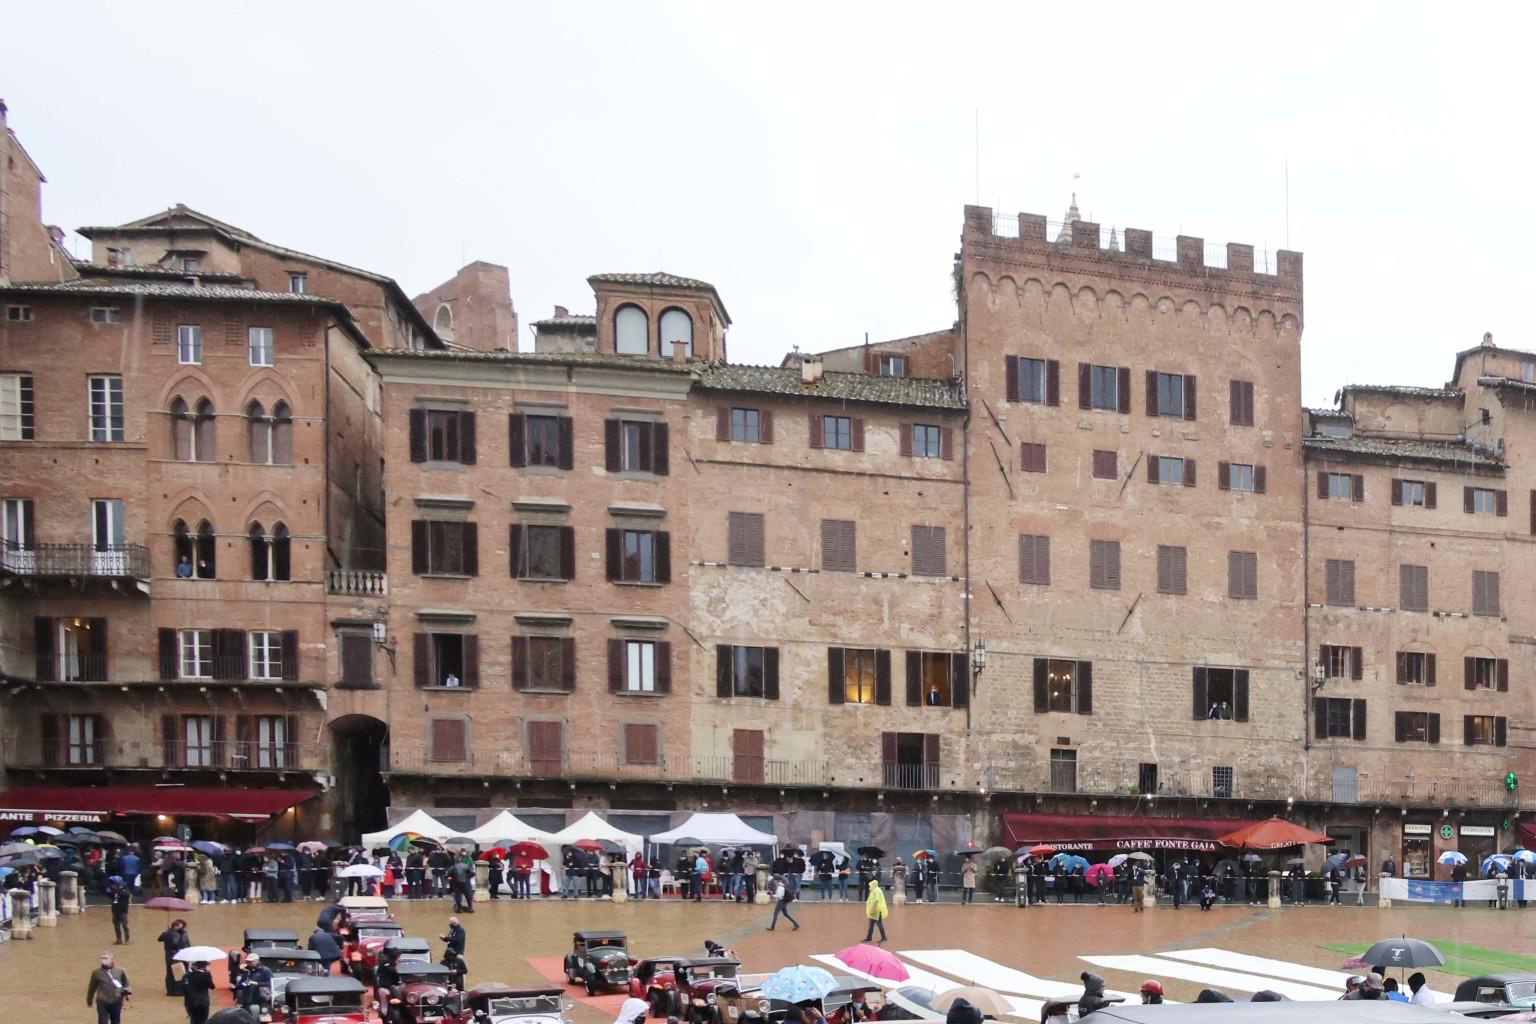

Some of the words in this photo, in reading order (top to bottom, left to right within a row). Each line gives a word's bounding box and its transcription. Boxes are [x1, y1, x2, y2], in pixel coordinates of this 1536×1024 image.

[44, 813, 101, 823] PIZZERIA
[1155, 839, 1189, 849] FONTE
[1191, 841, 1216, 851] GAIA
